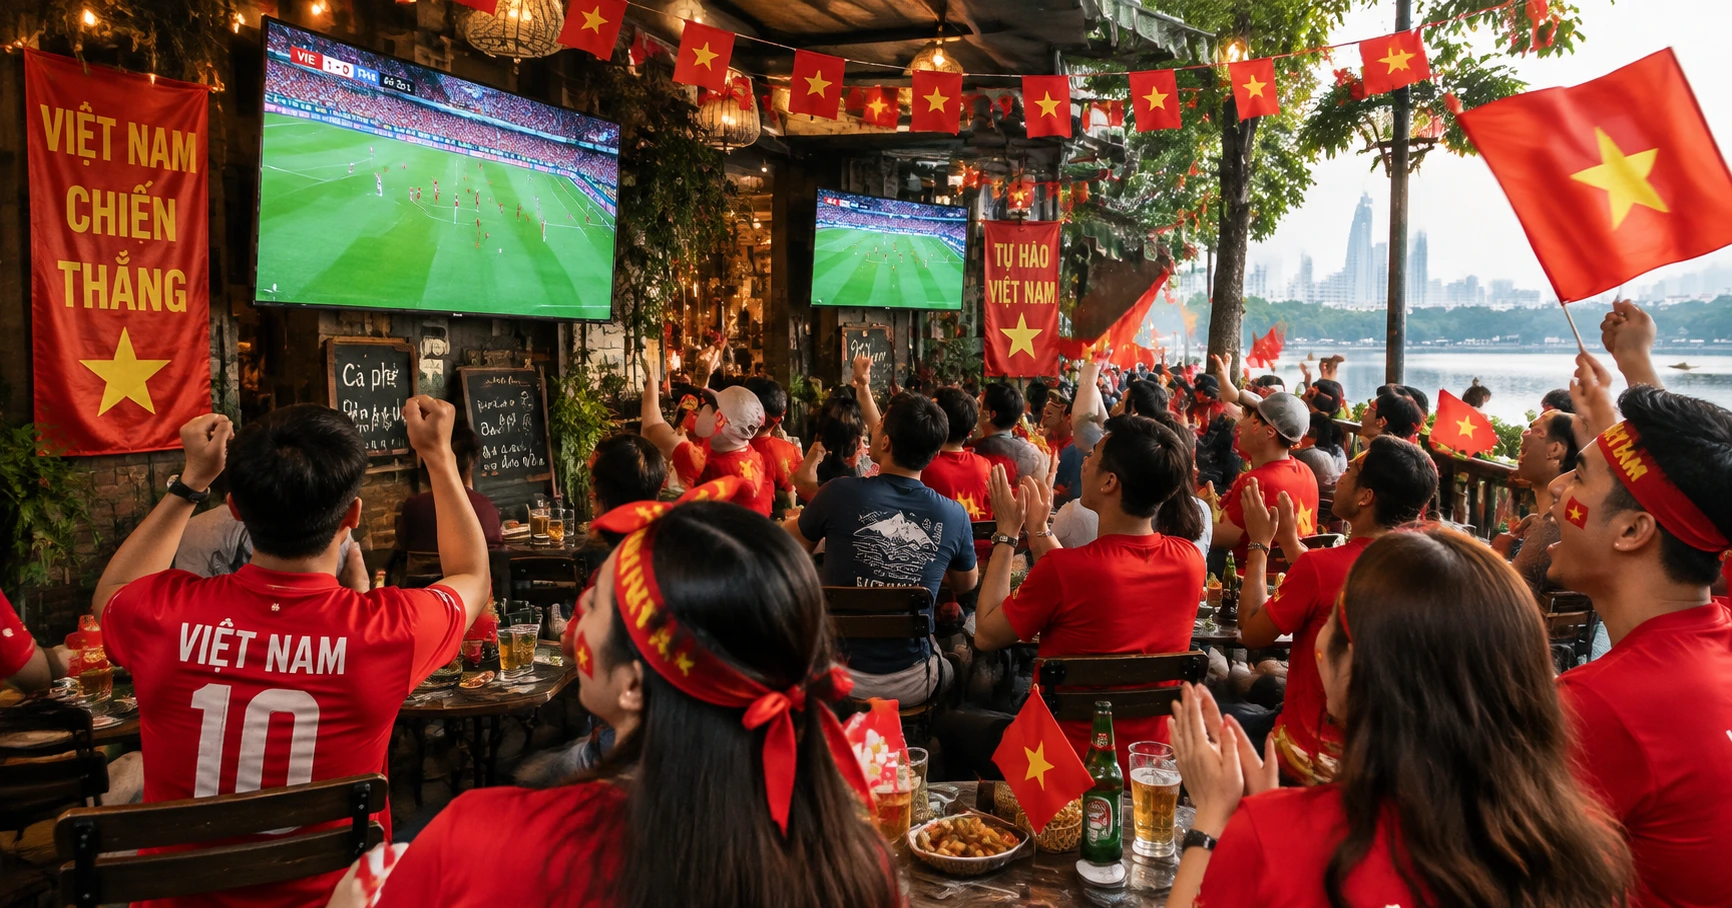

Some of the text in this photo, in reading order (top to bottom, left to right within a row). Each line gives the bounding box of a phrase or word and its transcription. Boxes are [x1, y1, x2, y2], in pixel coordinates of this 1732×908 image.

[297, 51, 316, 65] VIE
[128, 121, 197, 174] NAM
[994, 240, 1015, 271] TỰ
[988, 275, 1056, 308] VIỆT NAM
[342, 362, 365, 387] Cà
[179, 617, 348, 675] VIỆT NAM
[190, 683, 320, 799] 10
